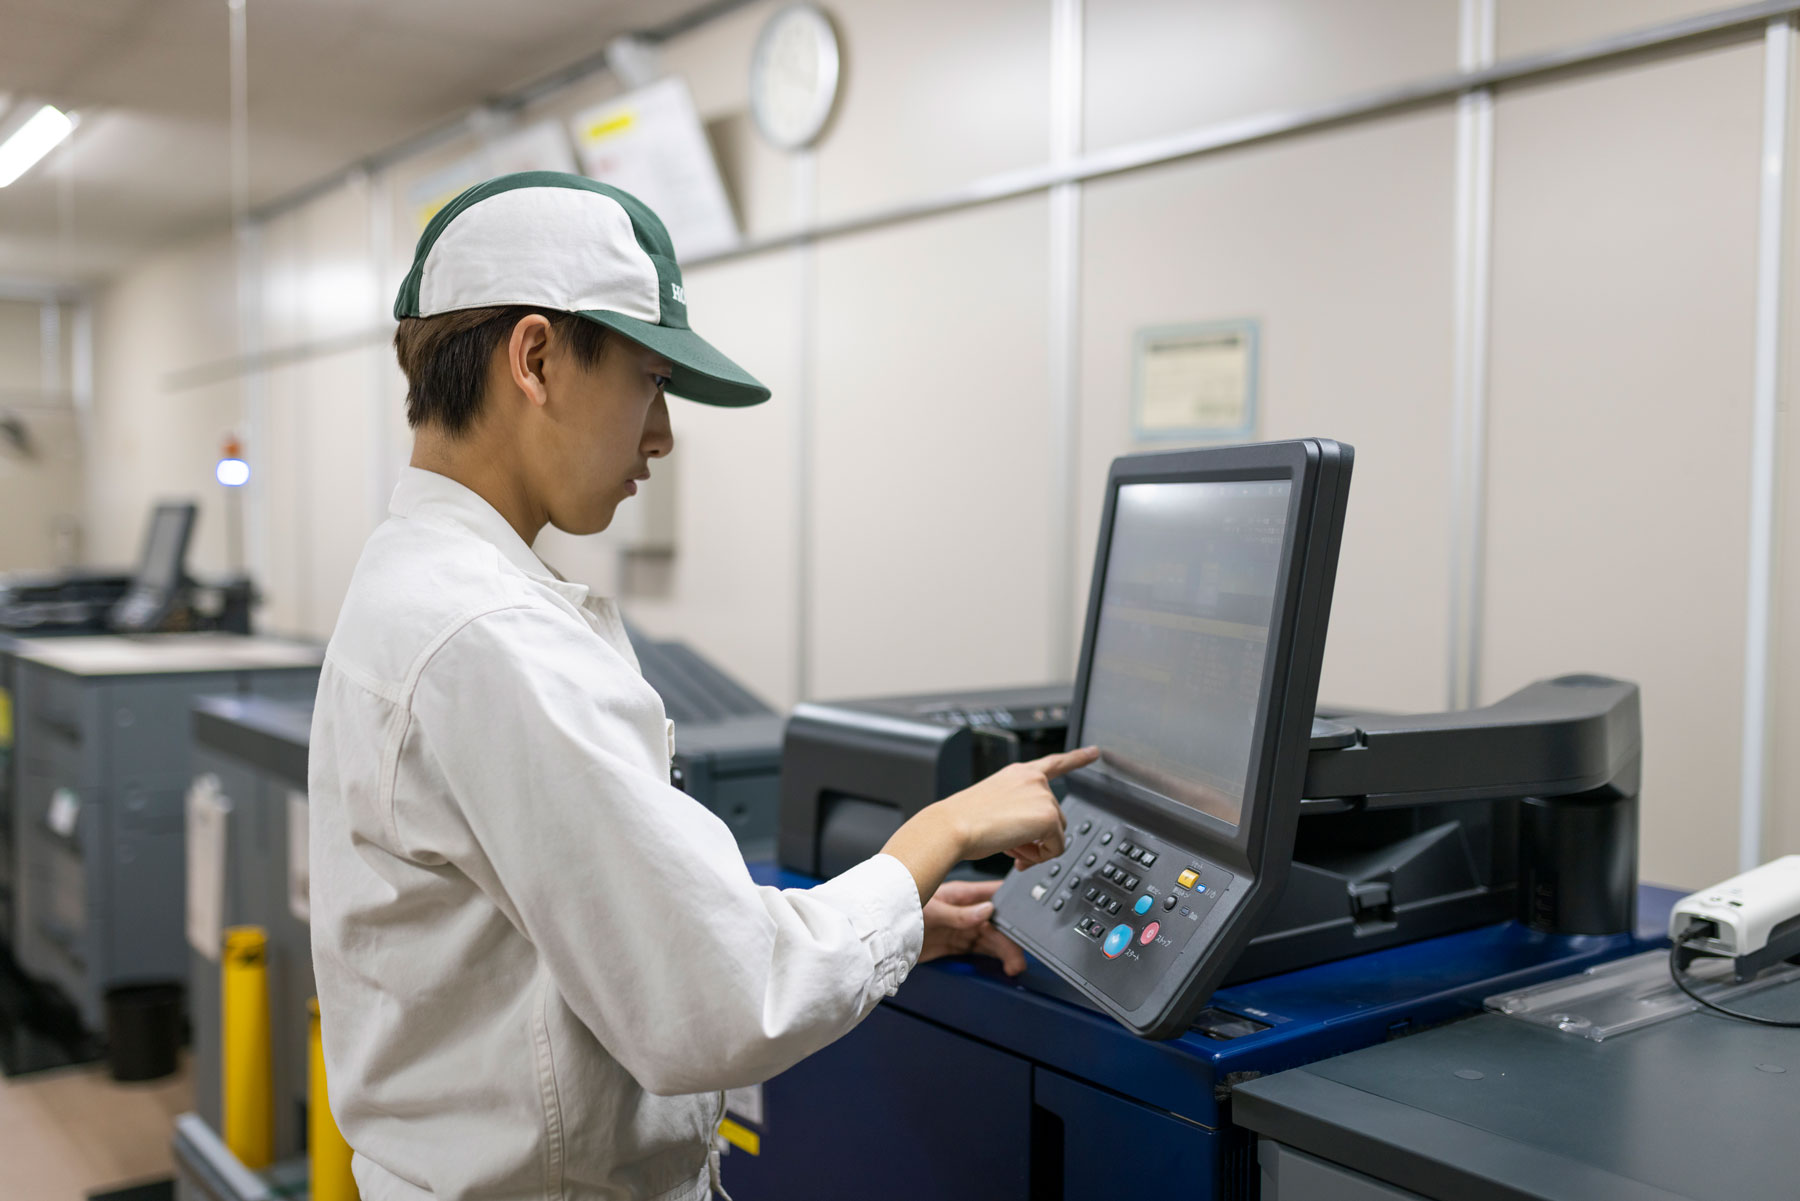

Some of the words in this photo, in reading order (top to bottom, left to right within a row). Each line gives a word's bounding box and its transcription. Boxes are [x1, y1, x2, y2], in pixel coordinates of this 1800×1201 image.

[1155, 934, 1172, 948] ストップ
[1125, 948, 1140, 961] スタート
